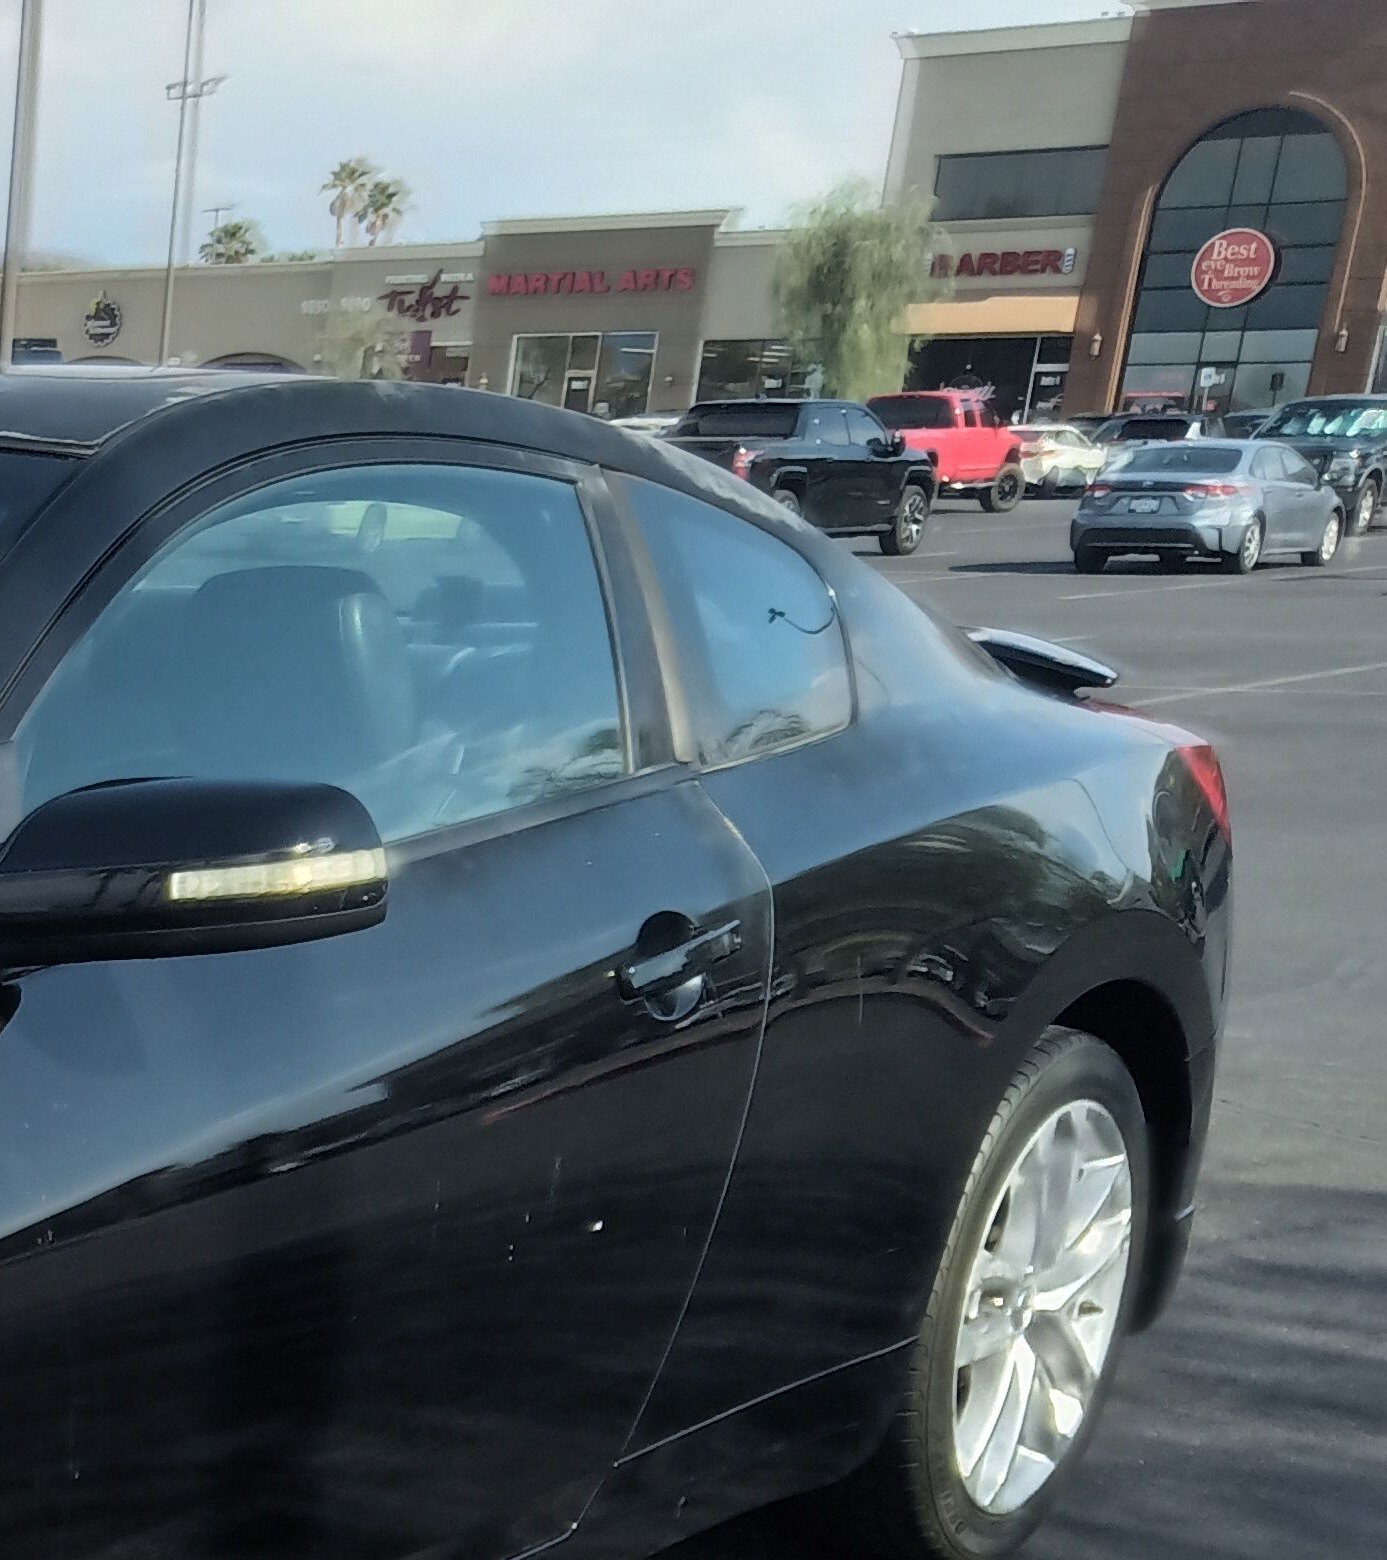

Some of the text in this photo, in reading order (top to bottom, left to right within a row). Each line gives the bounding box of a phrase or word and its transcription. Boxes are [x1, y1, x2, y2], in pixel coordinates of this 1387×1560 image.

[1211, 239, 1258, 260] Best
[1223, 263, 1261, 277] Brow
[488, 268, 695, 296] MARTIAL ARTS
[1201, 274, 1260, 291] Threading
